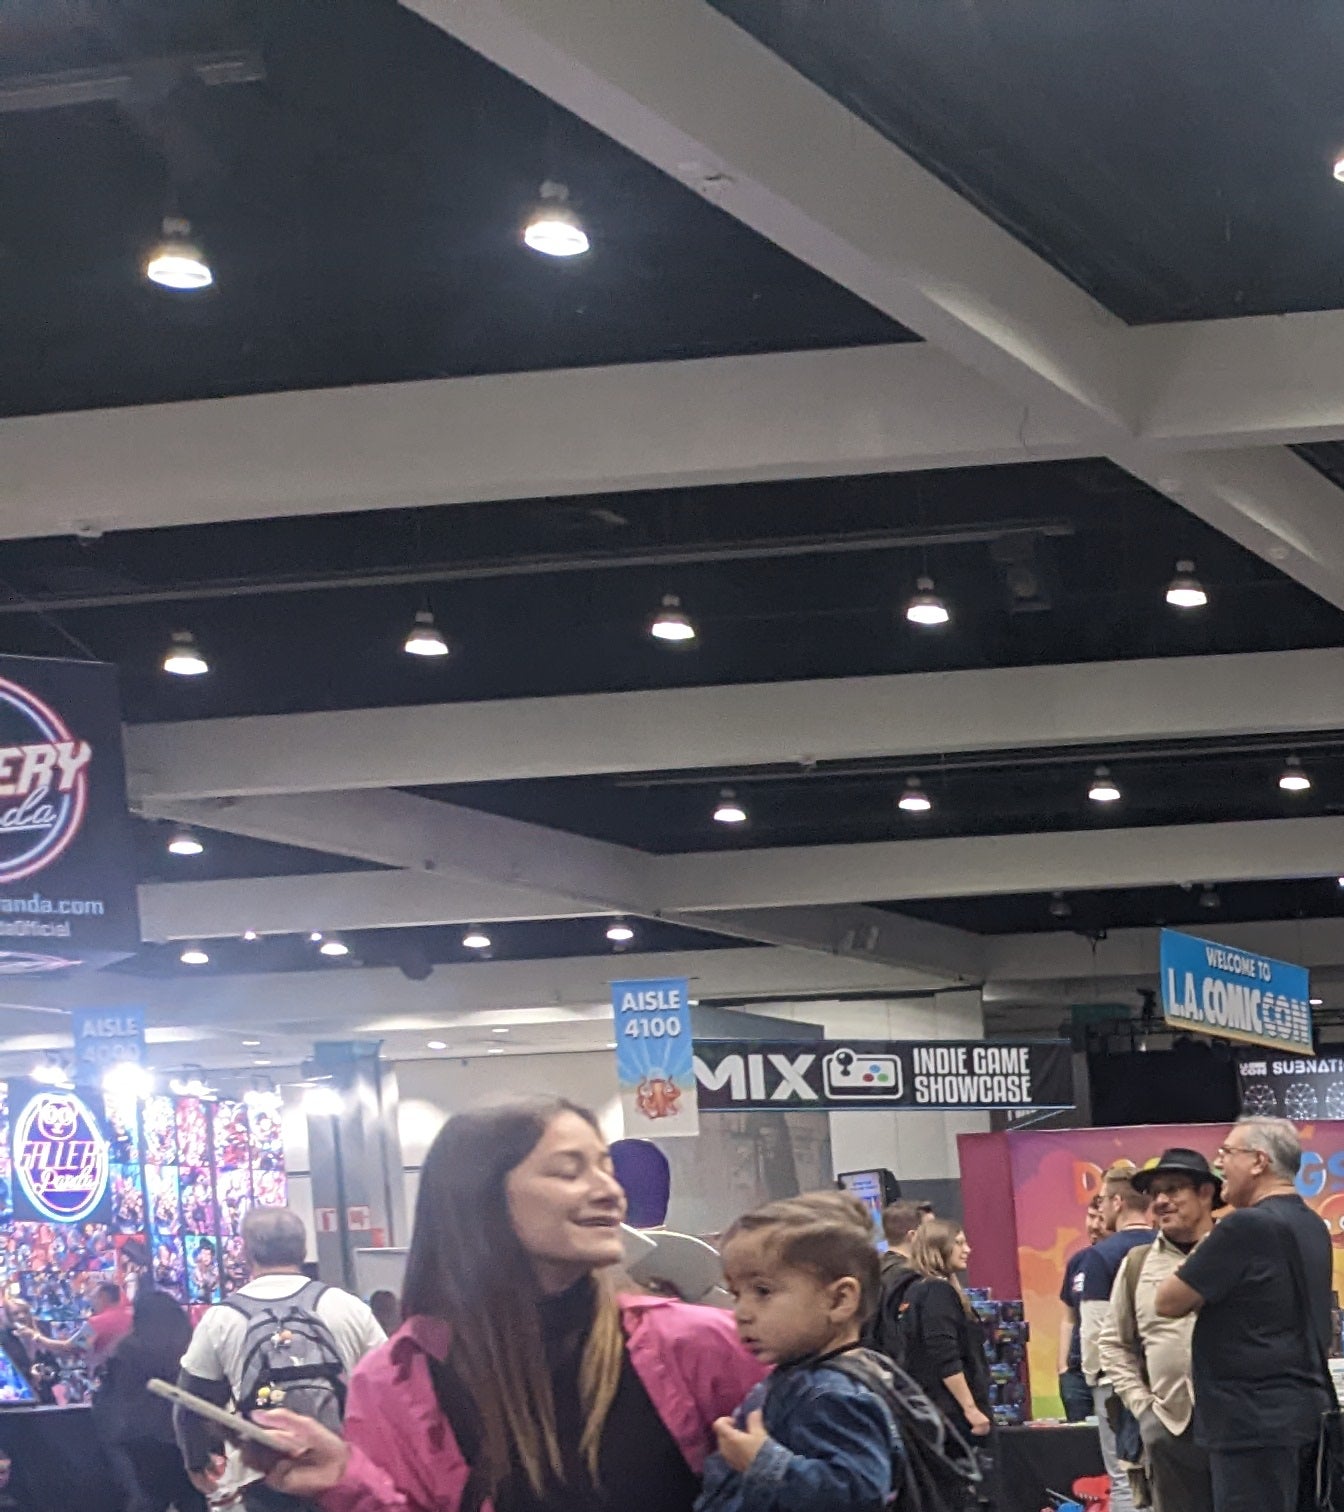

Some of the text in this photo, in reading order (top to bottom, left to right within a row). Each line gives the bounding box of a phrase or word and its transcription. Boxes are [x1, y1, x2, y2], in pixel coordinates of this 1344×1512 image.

[1206, 946, 1271, 982] WELCOME TO
[621, 990, 681, 1012] AISLE
[1168, 967, 1310, 1044] L.A. COMIC CON
[82, 1018, 139, 1038] AISLE
[624, 1017, 681, 1038] 4100
[912, 1047, 1030, 1075] INDIE GAME
[914, 1075, 1032, 1103] SHOWCASE
